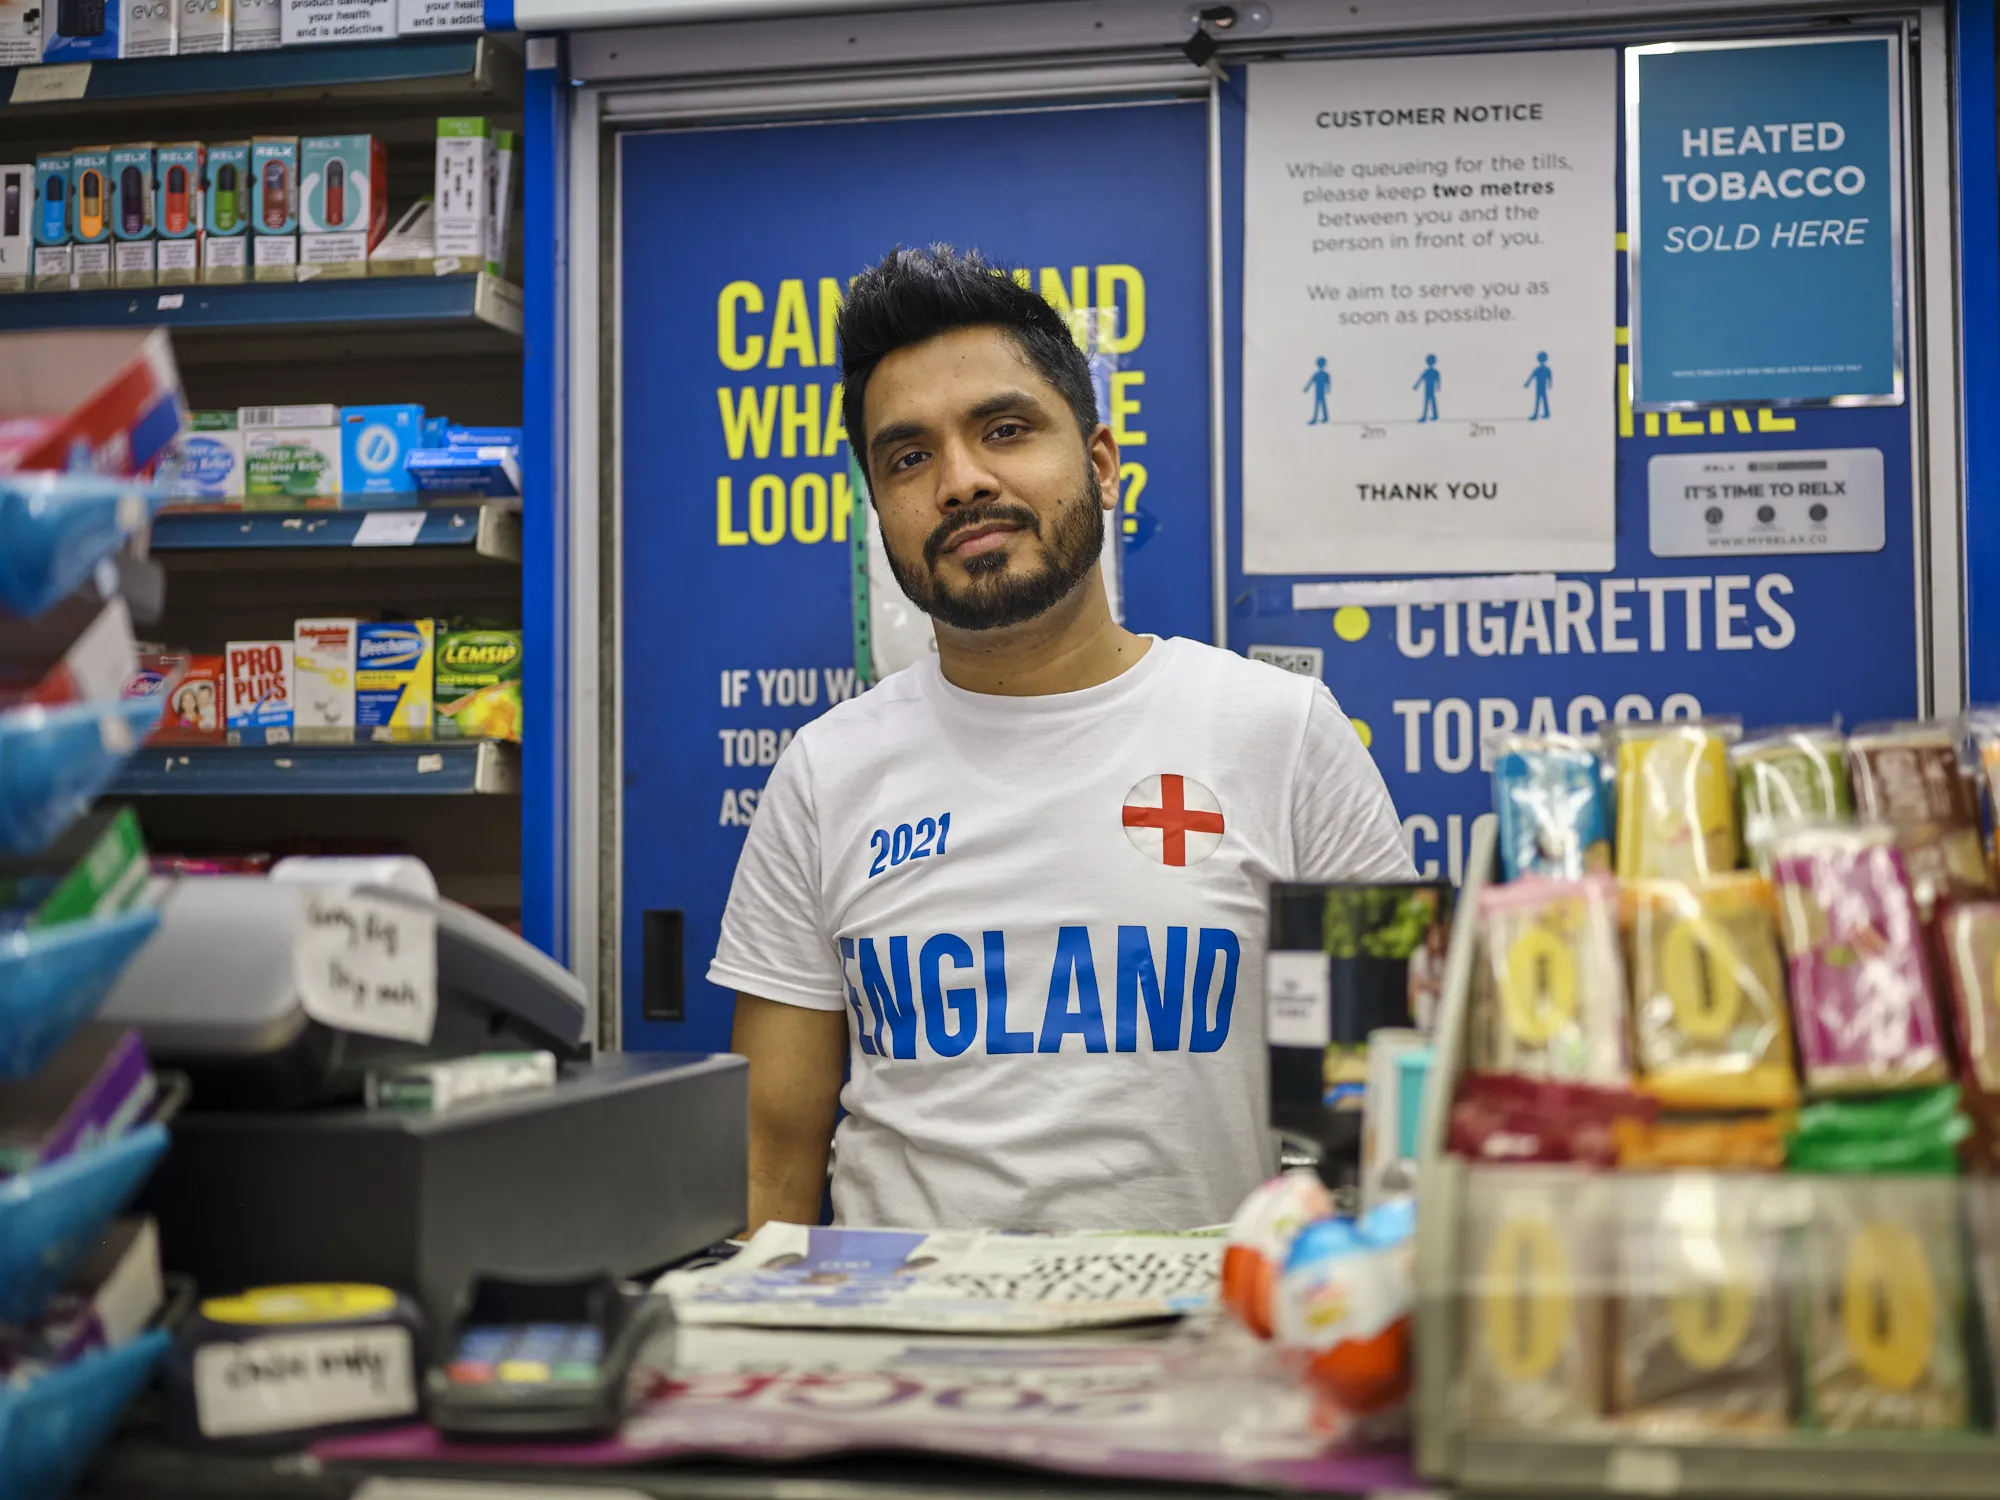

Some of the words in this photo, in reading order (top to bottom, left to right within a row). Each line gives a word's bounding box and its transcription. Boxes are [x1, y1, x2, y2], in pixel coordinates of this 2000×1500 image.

[132, 2, 167, 20] evo
[308, 13, 333, 24] your
[336, 10, 371, 20] health
[296, 28, 316, 37] and
[320, 27, 329, 36] is
[333, 24, 384, 35] addictive
[1316, 108, 1445, 128] CUSTOMER
[1453, 103, 1543, 123] NOTICE
[1682, 122, 1845, 157] HEATED
[114, 152, 147, 163] RELX
[160, 152, 194, 163] RELX
[255, 146, 292, 158] RELX
[1286, 161, 1345, 178] While
[1351, 158, 1448, 178] queueing
[1455, 155, 1483, 173] for
[1491, 155, 1525, 172] the
[1532, 153, 1573, 172] tills,
[1303, 185, 1369, 206] please
[1376, 184, 1426, 204] keep
[1433, 183, 1473, 199] two
[1480, 181, 1554, 197] metres
[1662, 166, 1866, 203] TOBACCO
[1318, 210, 1408, 227] between
[1413, 209, 1452, 228] you
[1459, 204, 1498, 222] and
[1505, 203, 1540, 221] the
[1312, 236, 1384, 255] person
[1390, 233, 1409, 249] in
[1415, 230, 1466, 249] front
[1472, 228, 1494, 247] of
[1500, 231, 1545, 250] you.
[1664, 224, 1760, 253] SOLD
[1771, 218, 1869, 248] HERE
[1306, 284, 1340, 301] We
[1346, 284, 1385, 301] aim
[1390, 283, 1413, 299] to
[1418, 283, 1476, 299] serve
[1481, 281, 1520, 301] you
[1526, 280, 1550, 296] as
[1338, 310, 1390, 326] soon
[1395, 309, 1418, 325] as
[1424, 303, 1516, 327] possible.
[1361, 424, 1386, 439] 2m
[1469, 422, 1496, 437] 2m
[1356, 483, 1437, 501] THANK
[1448, 482, 1498, 500] YOU
[1685, 485, 1717, 500] IT'S
[1720, 483, 1765, 499] TIME
[1769, 482, 1794, 497] TO
[1799, 481, 1847, 497] RELX
[1397, 573, 1796, 659] CIGARETTES
[231, 645, 283, 678] PRO
[446, 646, 517, 664] LEMSIP
[234, 675, 287, 704] PLUS
[720, 670, 750, 707] IF
[756, 668, 818, 706] YOU
[869, 812, 950, 878] 2021
